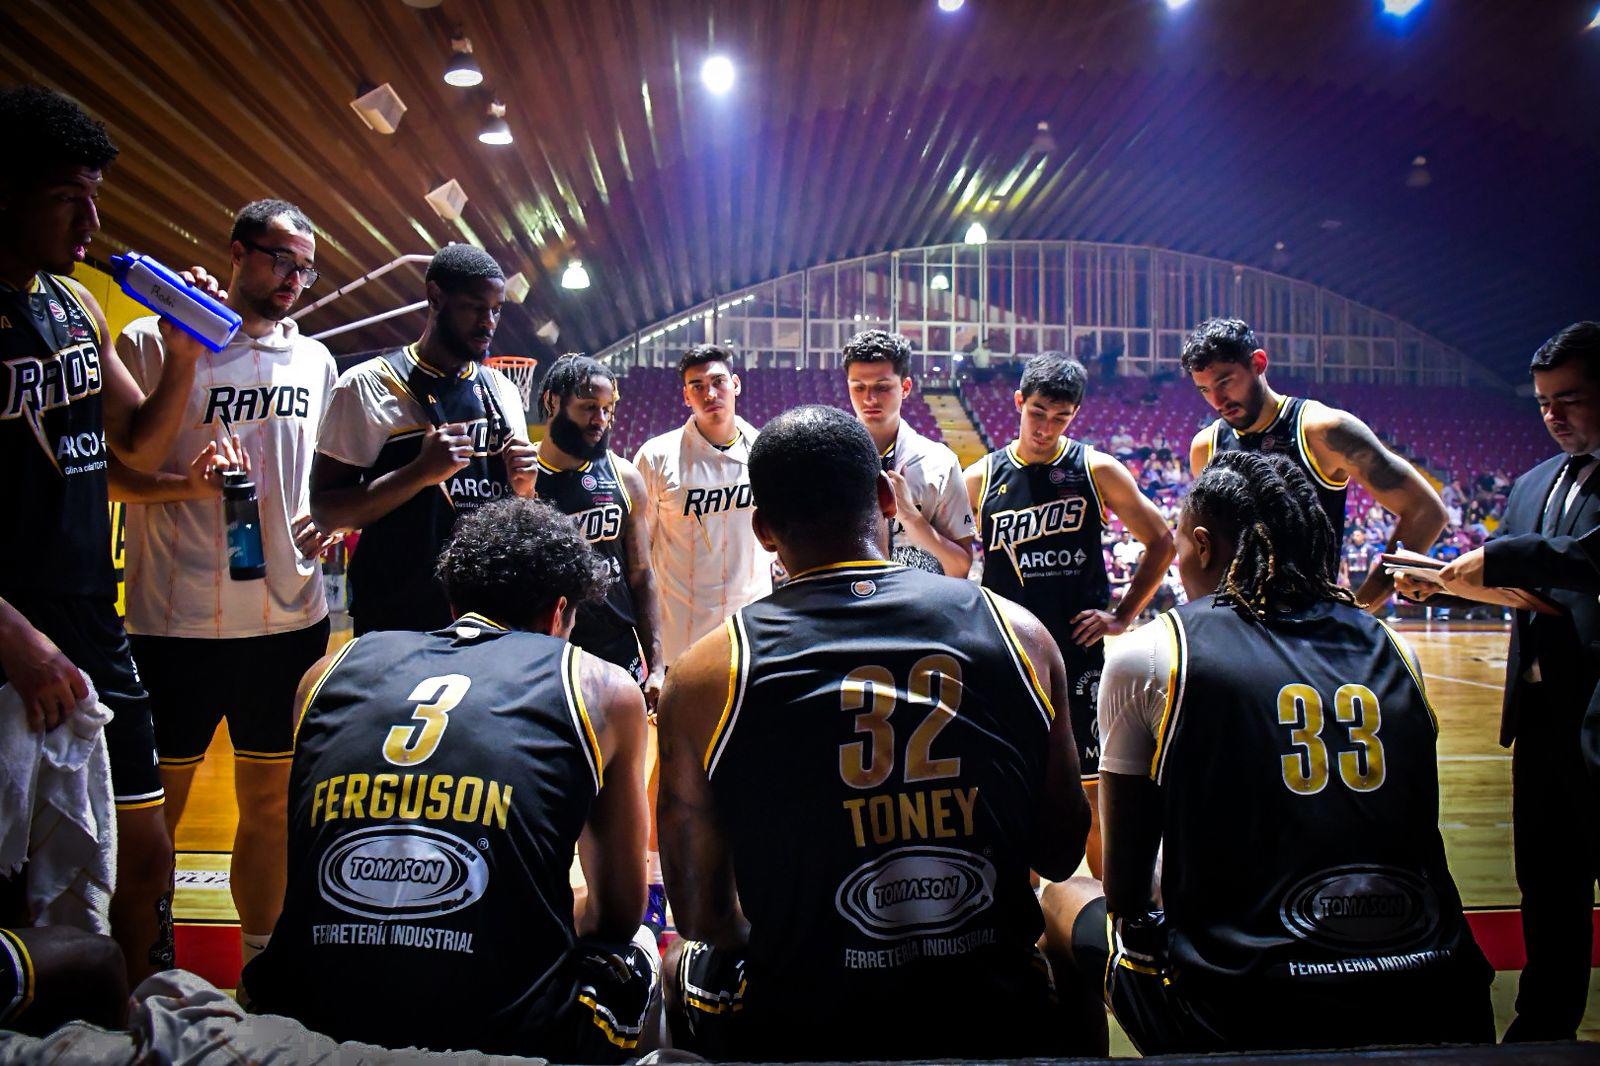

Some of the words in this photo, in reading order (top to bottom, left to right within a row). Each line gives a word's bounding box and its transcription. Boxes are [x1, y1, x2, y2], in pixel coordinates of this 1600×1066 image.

[203, 386, 310, 428] RAYOS
[450, 478, 501, 497] ARCO
[683, 484, 756, 520] RAYO
[990, 497, 1087, 551] RAYOS
[1019, 549, 1072, 569] ARCO
[381, 673, 472, 767] 3
[838, 653, 963, 790] 32
[1276, 683, 1387, 796] 33
[310, 773, 513, 830] FERGUSON
[843, 786, 978, 848] TONEY
[349, 856, 444, 884] TOMASON
[872, 875, 960, 908] TOMASON
[1319, 894, 1406, 921] TOMASON
[390, 924, 474, 954] INDUSTRIAL
[922, 927, 998, 957] INDUSTRIAL
